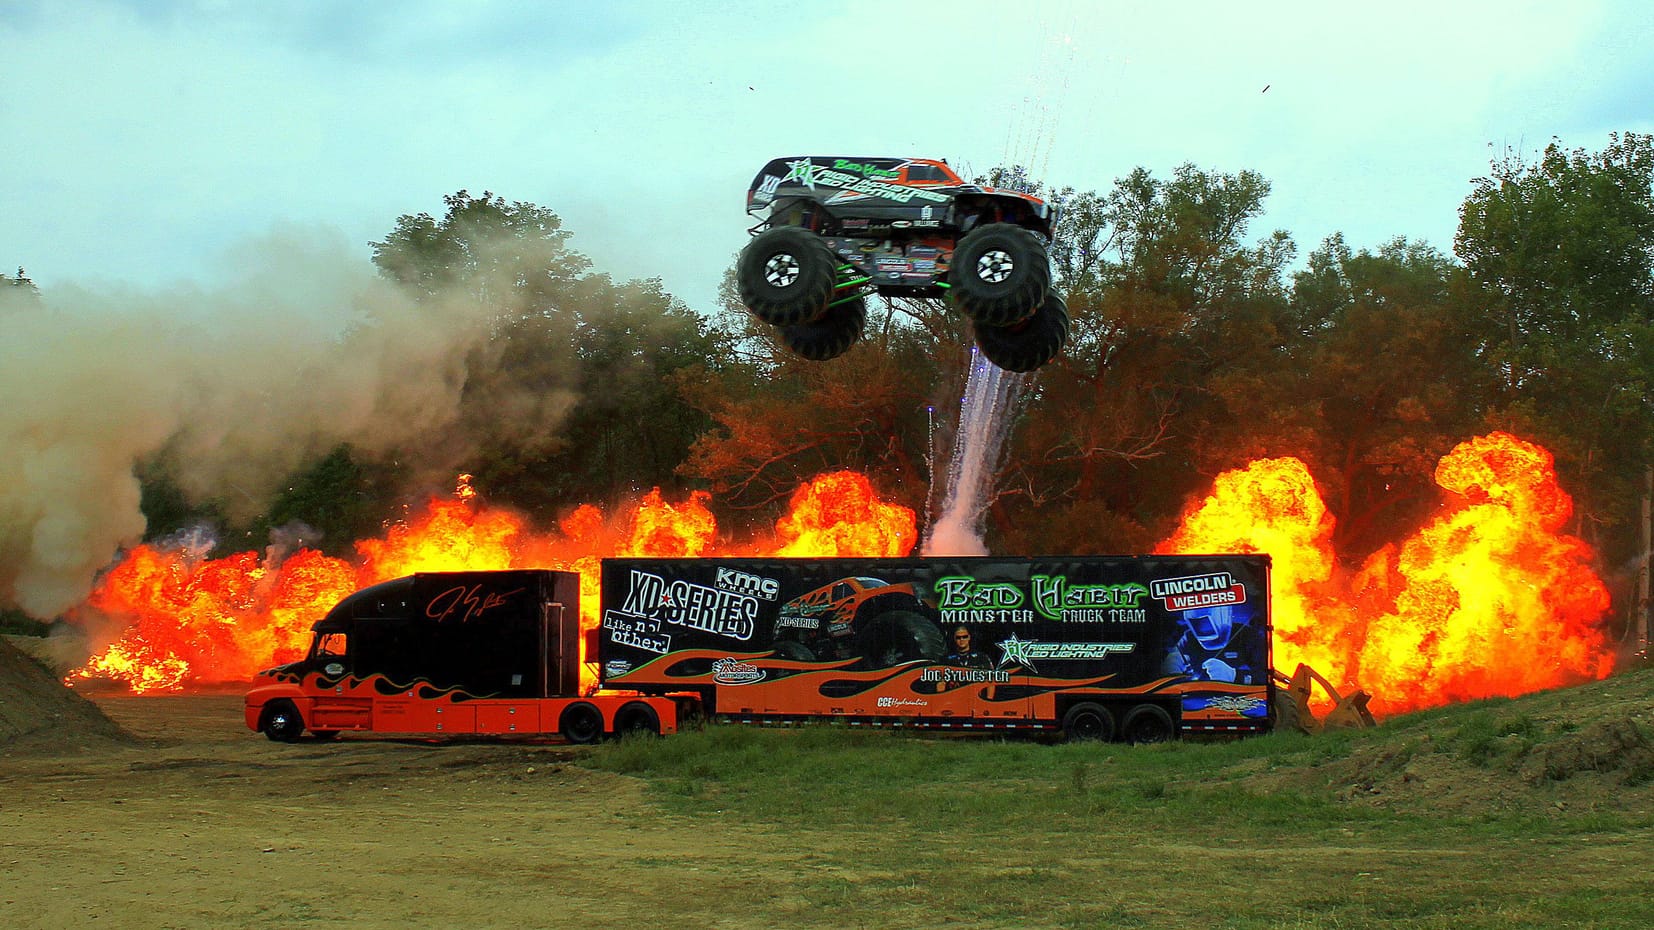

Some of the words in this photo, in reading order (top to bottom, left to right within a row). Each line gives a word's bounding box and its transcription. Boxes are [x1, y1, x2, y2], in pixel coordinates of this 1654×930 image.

[858, 178, 951, 203] INDUSTRIES
[1155, 575, 1228, 597] LINCOLN
[1172, 590, 1237, 608] WELDERS
[940, 609, 1034, 624] MONSTER
[1060, 608, 1104, 624] TRUCK
[1108, 609, 1146, 624] TEAM
[1026, 643, 1060, 652] RIGID
[1059, 643, 1134, 652] INDUSTRIES
[1049, 650, 1107, 659] LIGHTING
[877, 697, 892, 708] CCE
